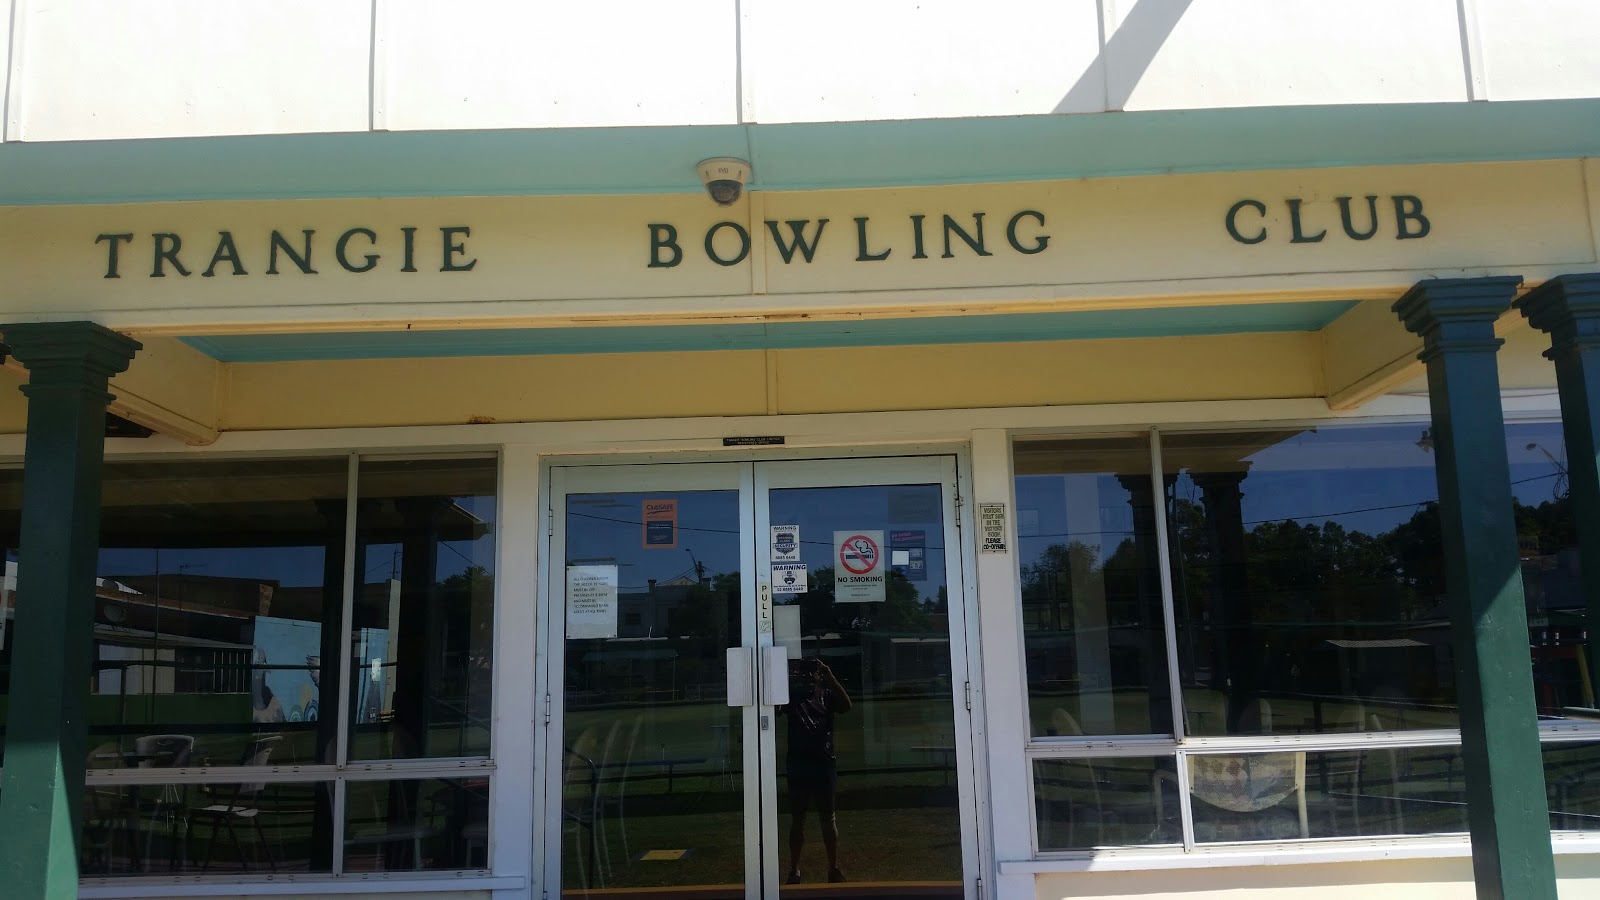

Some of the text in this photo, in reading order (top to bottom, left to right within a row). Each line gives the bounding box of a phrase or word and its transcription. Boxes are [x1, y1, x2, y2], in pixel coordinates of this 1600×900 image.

[95, 194, 1431, 279] TRANGIE BOWLING CLUB
